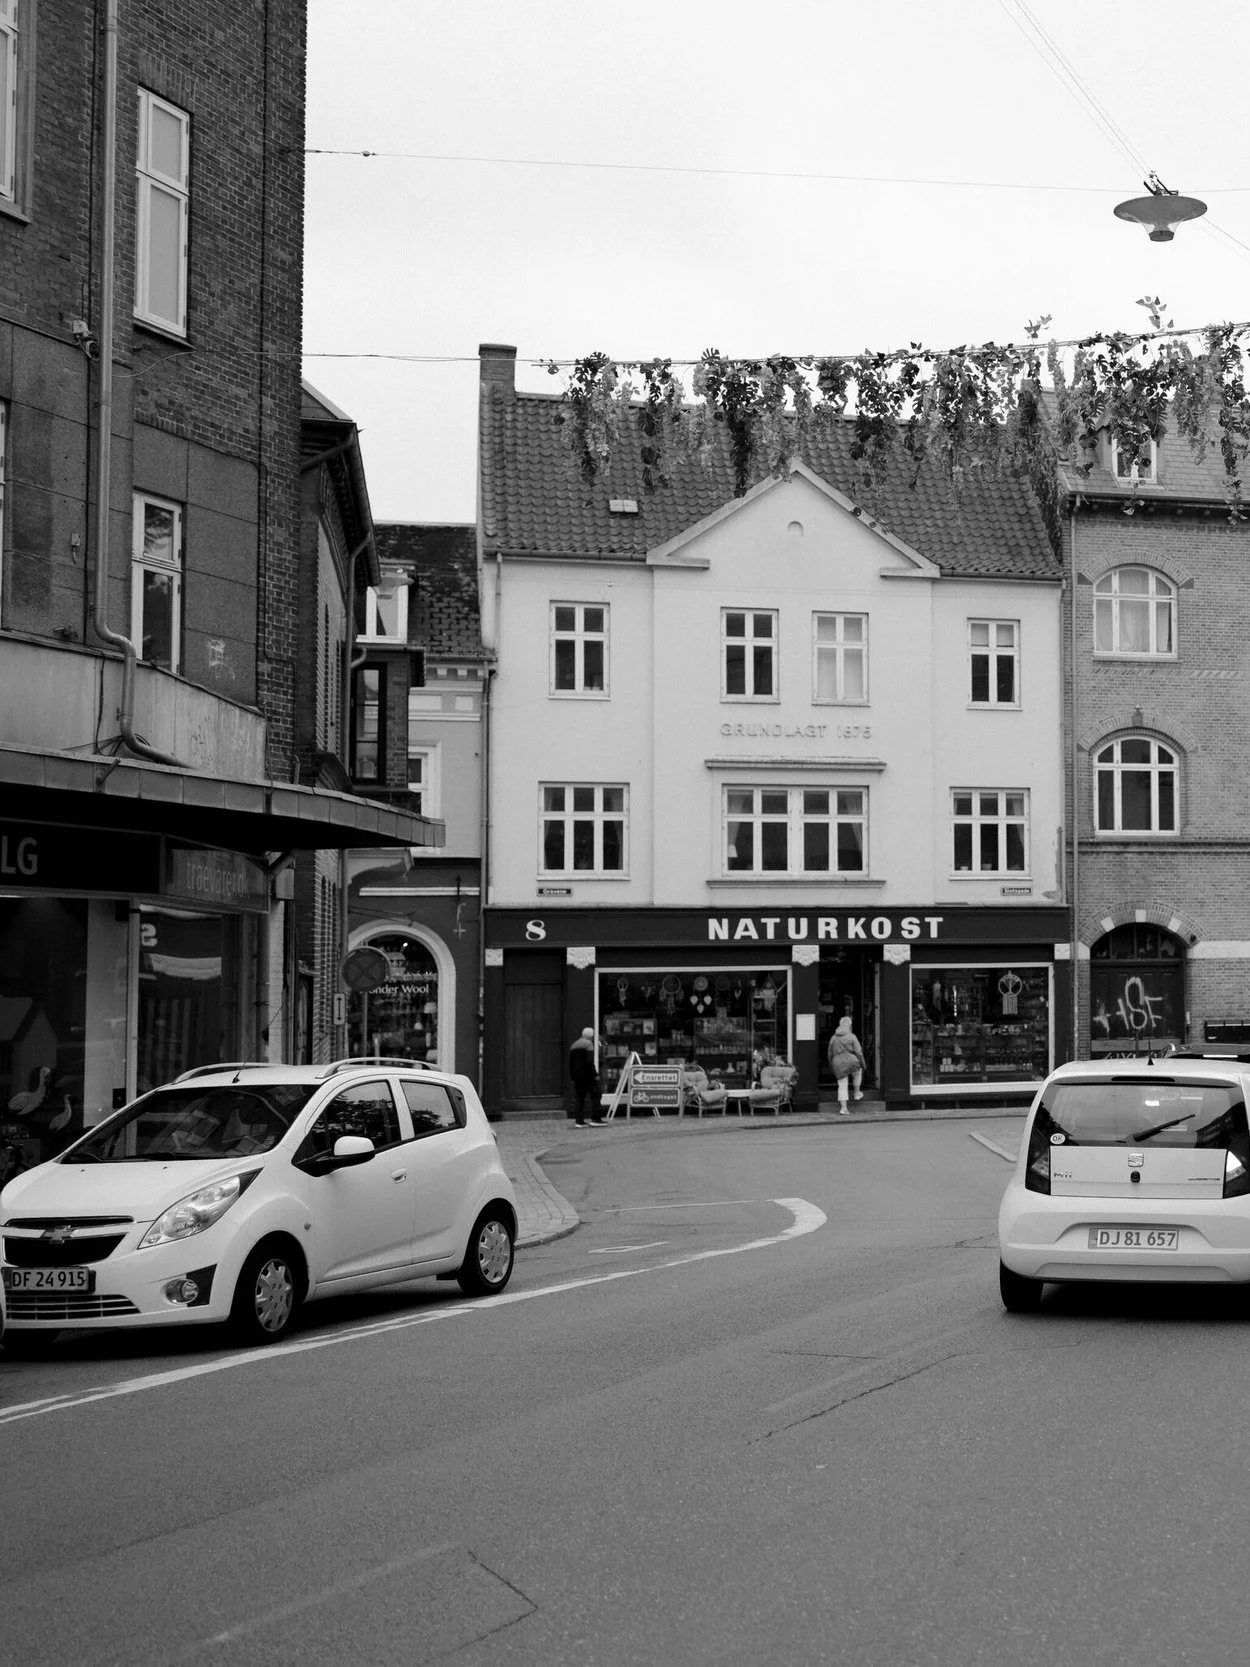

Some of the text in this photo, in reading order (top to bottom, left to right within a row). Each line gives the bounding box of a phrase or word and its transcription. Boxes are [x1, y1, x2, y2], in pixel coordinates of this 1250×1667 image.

[719, 722, 829, 739] GRUNDLAGT
[0, 835, 38, 876] LG
[525, 919, 547, 941] 8
[708, 917, 944, 940] NATURKOST
[401, 984, 430, 994] Wool
[1099, 1231, 1176, 1247] DJ 81 657
[12, 1271, 86, 1287] DF 24 915
